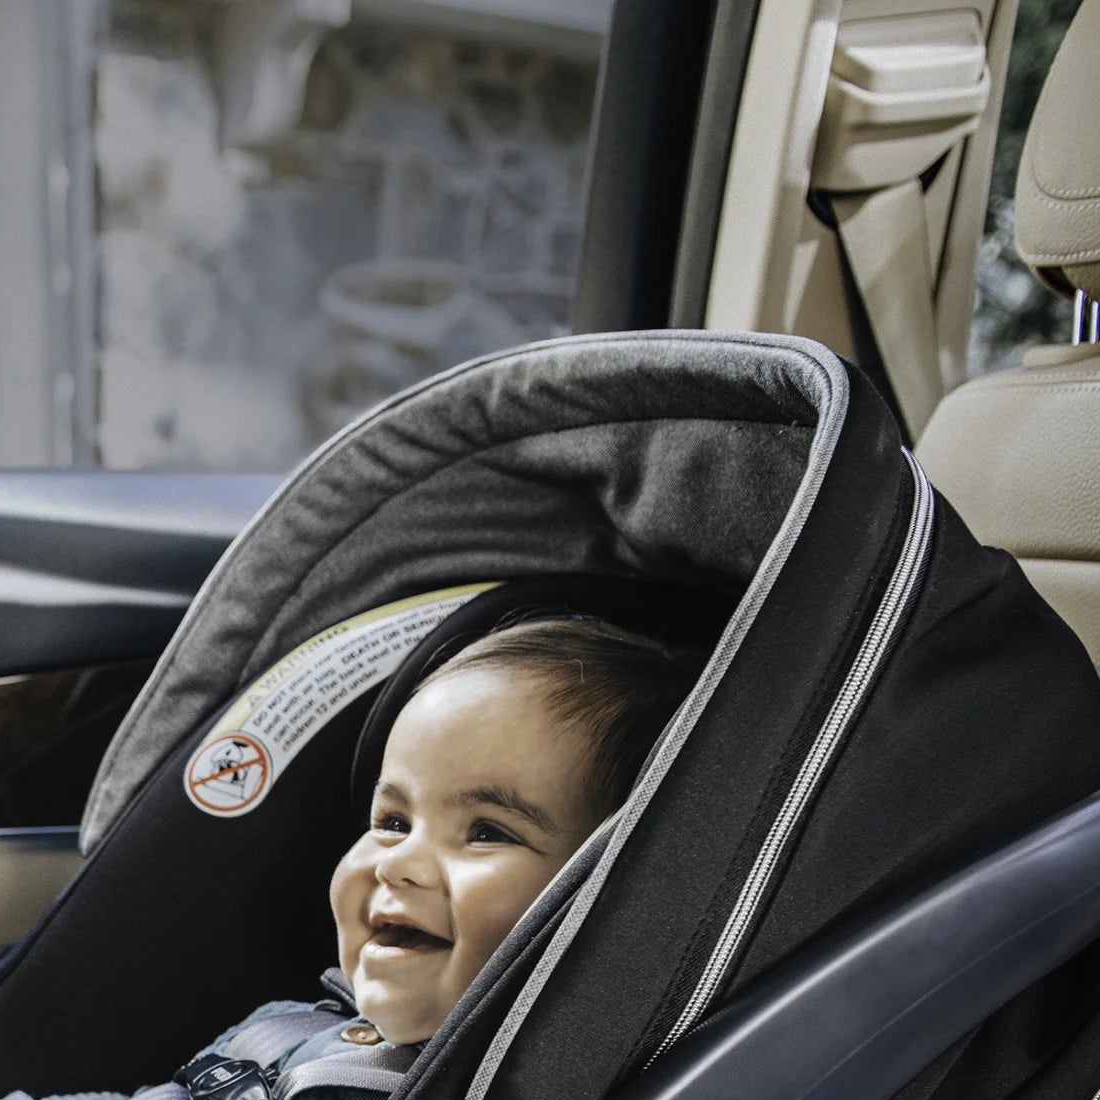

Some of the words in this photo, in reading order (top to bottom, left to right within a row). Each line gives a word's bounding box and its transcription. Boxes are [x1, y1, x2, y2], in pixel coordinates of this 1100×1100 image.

[341, 639, 380, 664] DEATH
[319, 680, 339, 695] The
[253, 709, 269, 727] DO
[267, 690, 286, 710] NOT
[282, 714, 316, 751] children
[329, 687, 349, 705] and
